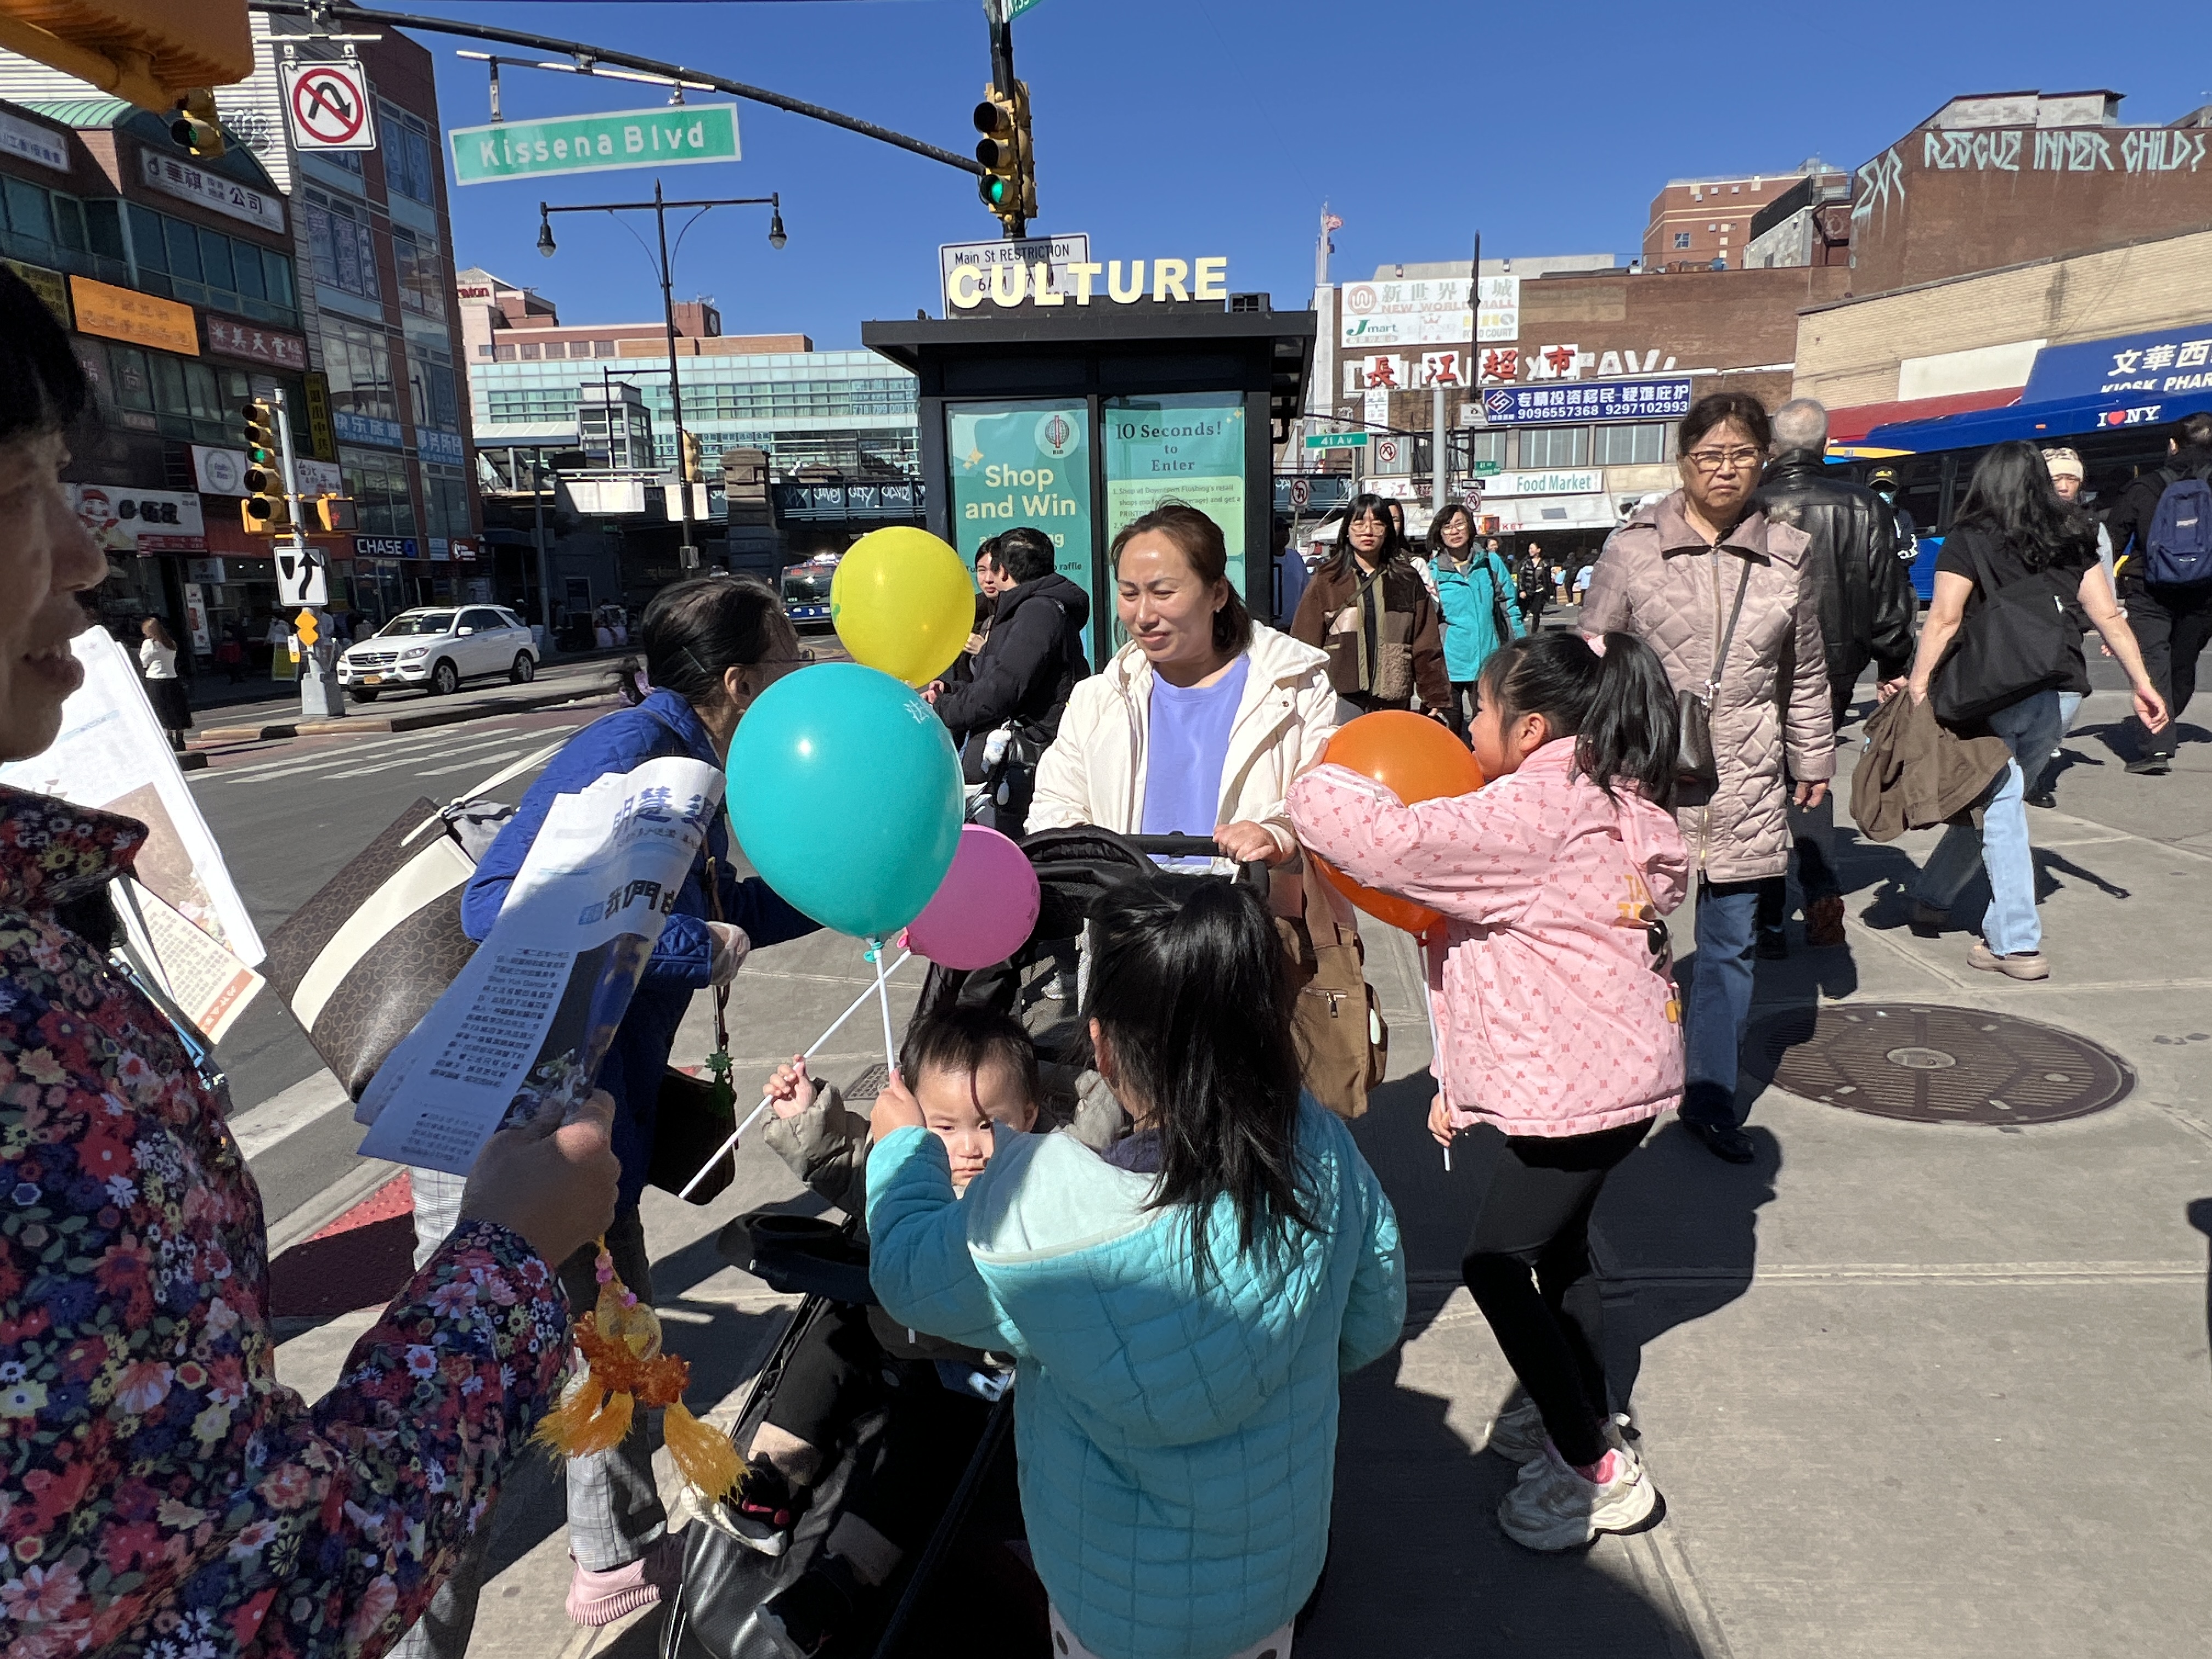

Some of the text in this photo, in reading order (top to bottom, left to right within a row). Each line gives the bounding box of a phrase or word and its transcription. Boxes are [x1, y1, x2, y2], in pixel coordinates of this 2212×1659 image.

[480, 120, 704, 167] Kissena Blvd
[1925, 131, 2023, 171] RESCUE
[2034, 131, 2114, 171] INNER
[229, 186, 263, 215] 公司
[955, 244, 1069, 265] Main St RESTRICTION
[949, 257, 1228, 309] CULTURE
[1381, 300, 1515, 314] NEW WORLD MALL
[1463, 329, 1483, 338] FOD
[1486, 328, 1513, 338] COURT
[1367, 345, 1575, 388] 長江超市
[2107, 338, 2212, 377] 文華西
[1518, 405, 1599, 420] 9096557368
[1606, 402, 1688, 416] 9297102993
[2097, 405, 2162, 427] I NY
[1115, 420, 1222, 439] 10 Seconds!
[1164, 444, 1178, 454] to
[1321, 437, 1333, 445] 41
[1151, 459, 1195, 472] Enter
[984, 464, 1054, 493] Shop
[1517, 473, 1592, 492] Food Market
[1181, 485, 1214, 493] Flushing's
[966, 494, 1076, 520] and Win
[357, 539, 403, 555] CHASE
[1059, 562, 1082, 571] raffle
